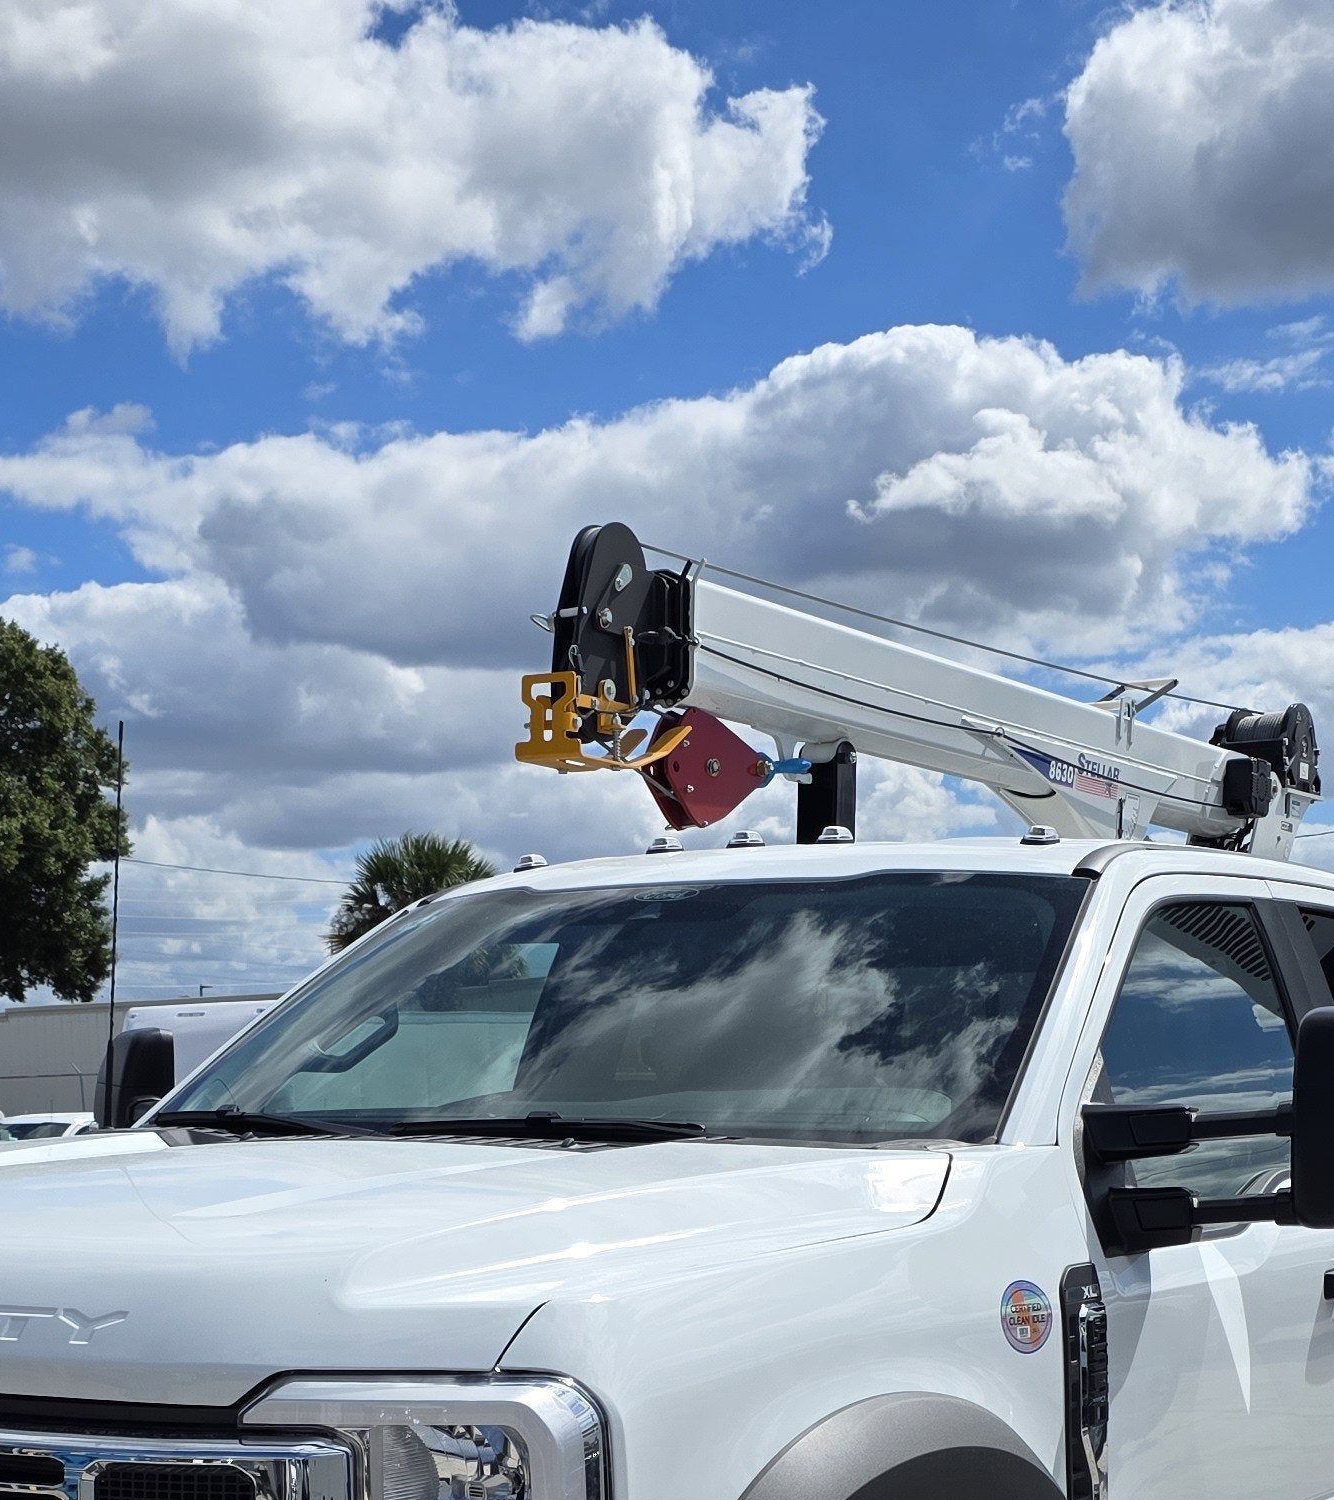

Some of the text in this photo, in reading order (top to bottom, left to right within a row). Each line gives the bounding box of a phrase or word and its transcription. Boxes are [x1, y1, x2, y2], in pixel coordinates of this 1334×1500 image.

[1048, 760, 1075, 784] 8630
[1080, 1285, 1098, 1300] XL
[1010, 1302, 1042, 1314] CERTIFIED
[1008, 1313, 1046, 1326] CLEAN IDLE
